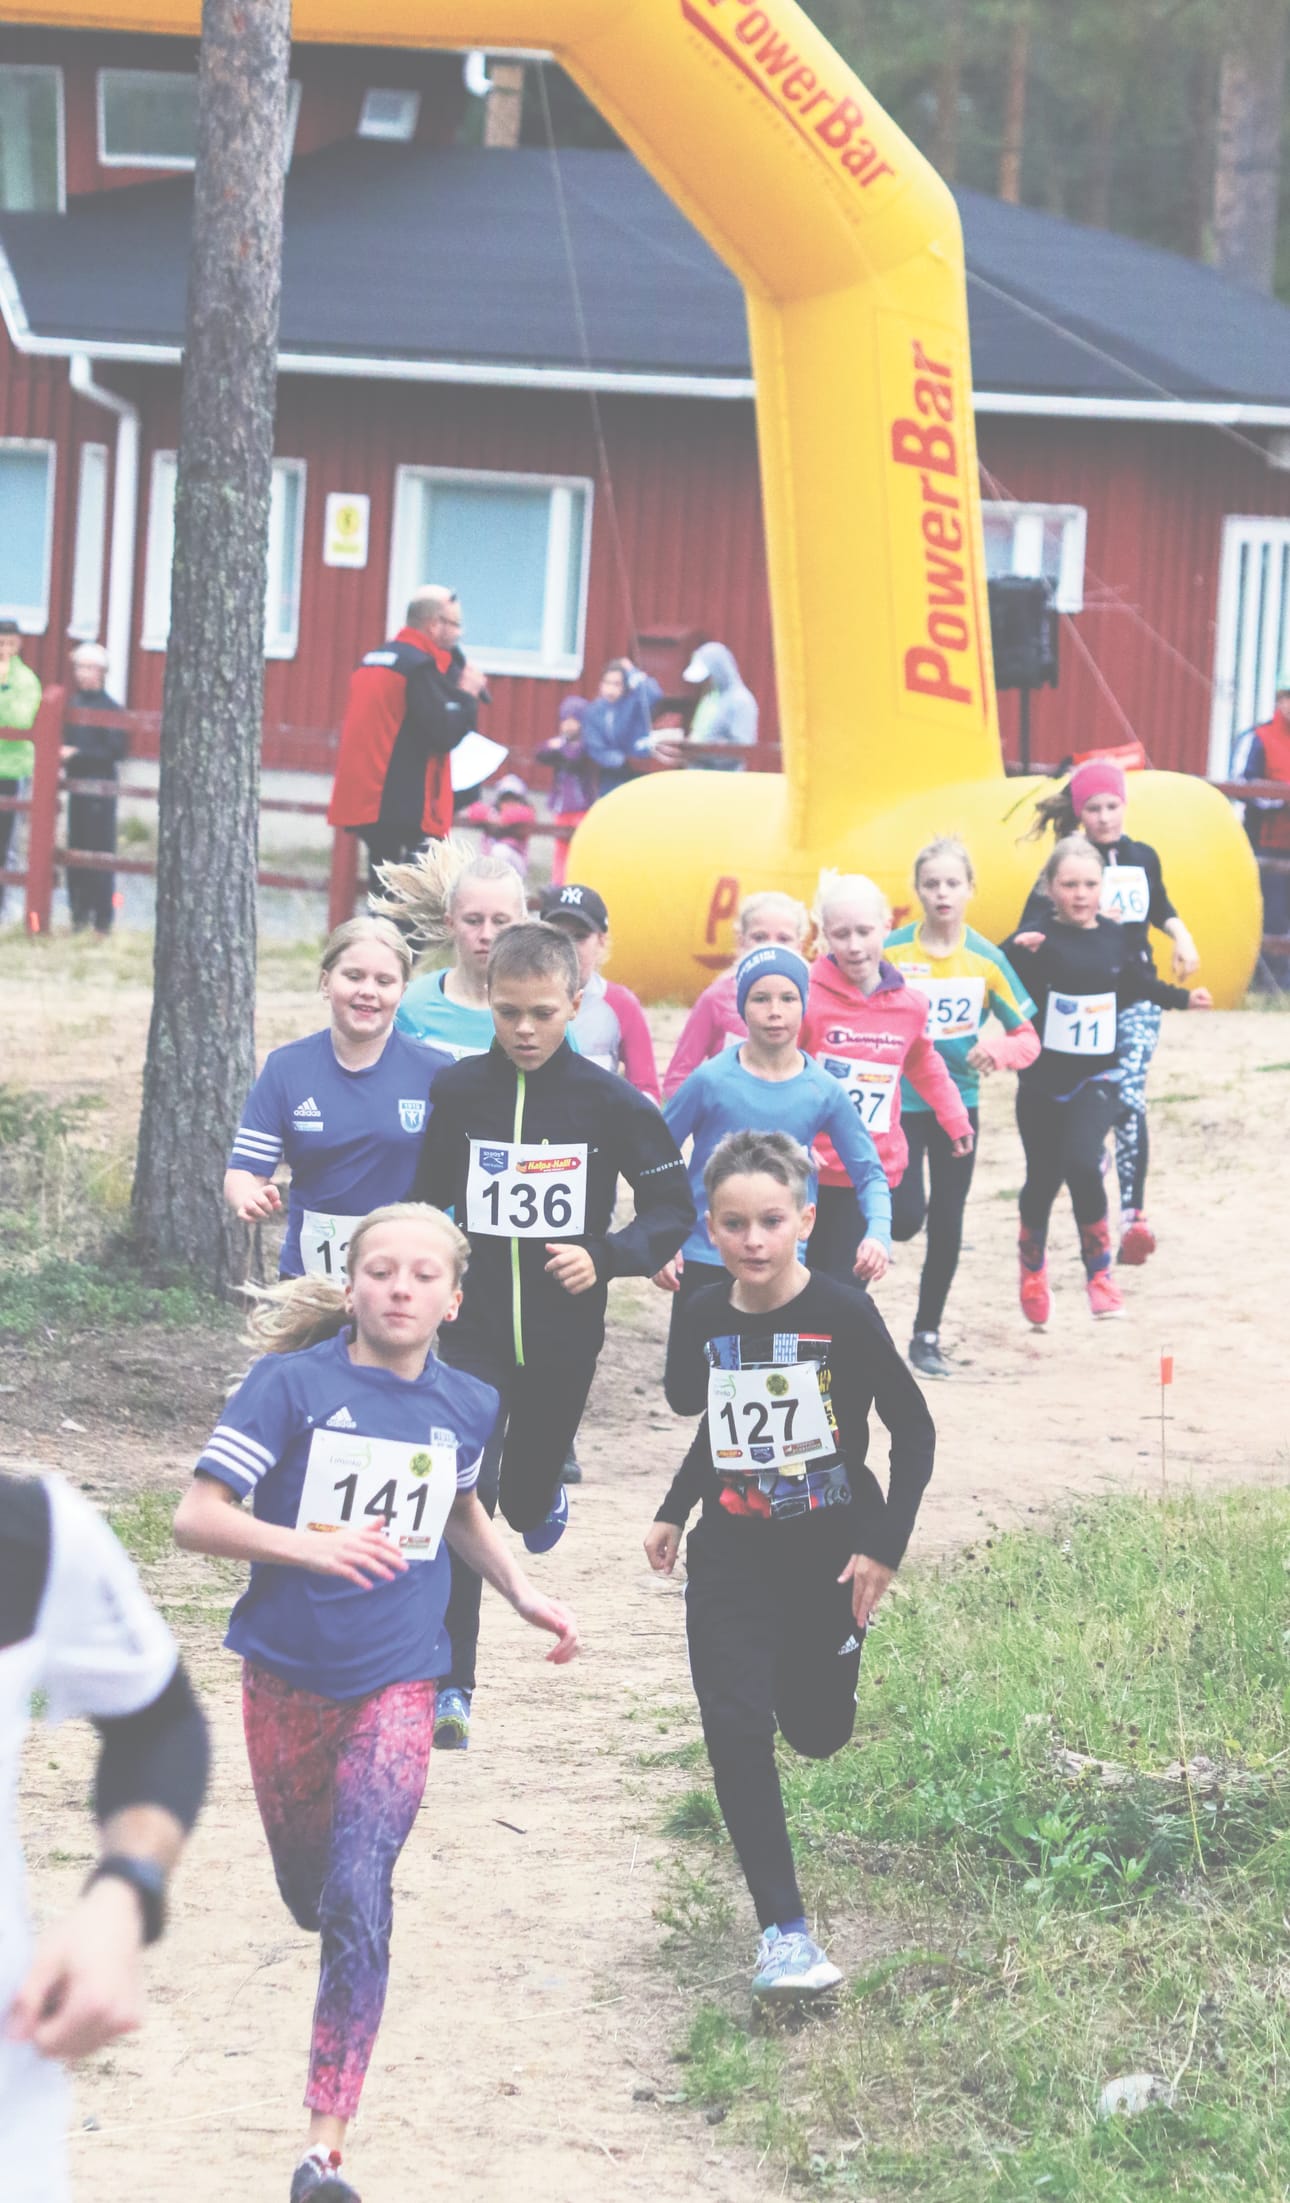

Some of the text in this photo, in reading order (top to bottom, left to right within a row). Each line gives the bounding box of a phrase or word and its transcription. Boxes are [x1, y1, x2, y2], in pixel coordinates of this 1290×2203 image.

[891, 339, 973, 706] PowerBar
[928, 998, 972, 1024] 52
[1068, 1019, 1099, 1048] 11
[293, 1109, 321, 1117] adidas
[482, 1181, 572, 1229] 136
[720, 1399, 799, 1446] 127
[333, 1474, 429, 1532] 141
